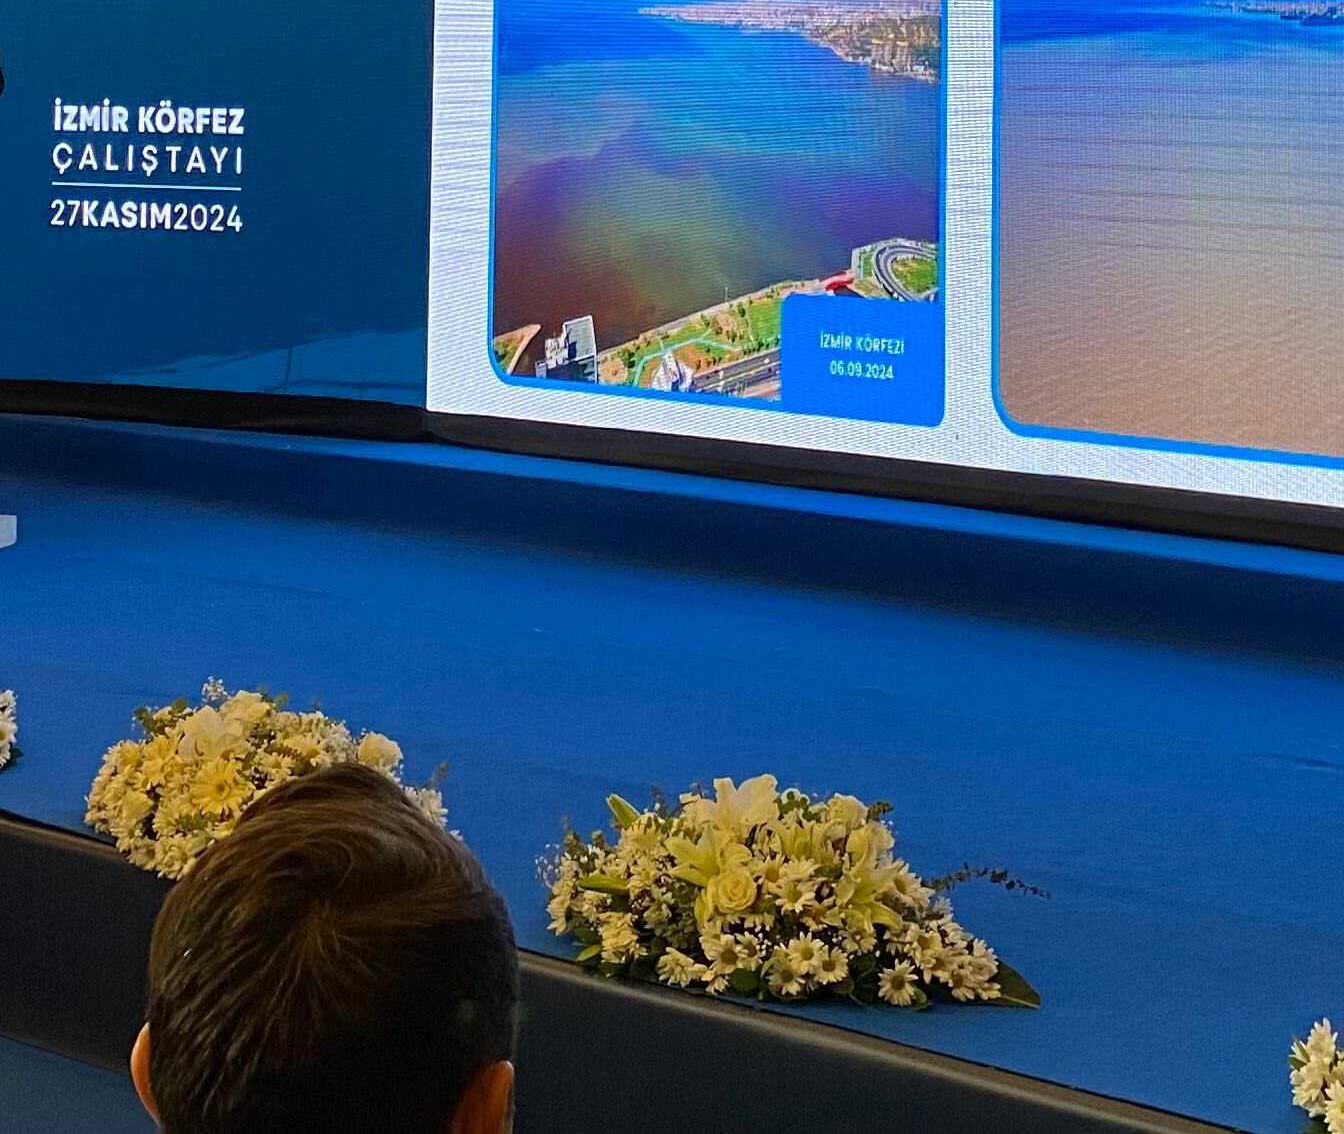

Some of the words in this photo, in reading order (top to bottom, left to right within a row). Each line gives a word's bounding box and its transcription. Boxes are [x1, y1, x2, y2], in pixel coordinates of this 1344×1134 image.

[53, 97, 129, 134] İZMİR
[138, 100, 245, 135] KÖRFEZ
[52, 142, 243, 177] ÇALIŞTAYI
[49, 198, 244, 233] 27KASIM2024
[820, 329, 853, 351] İZMİR
[855, 333, 906, 355] KÖRFEZİ
